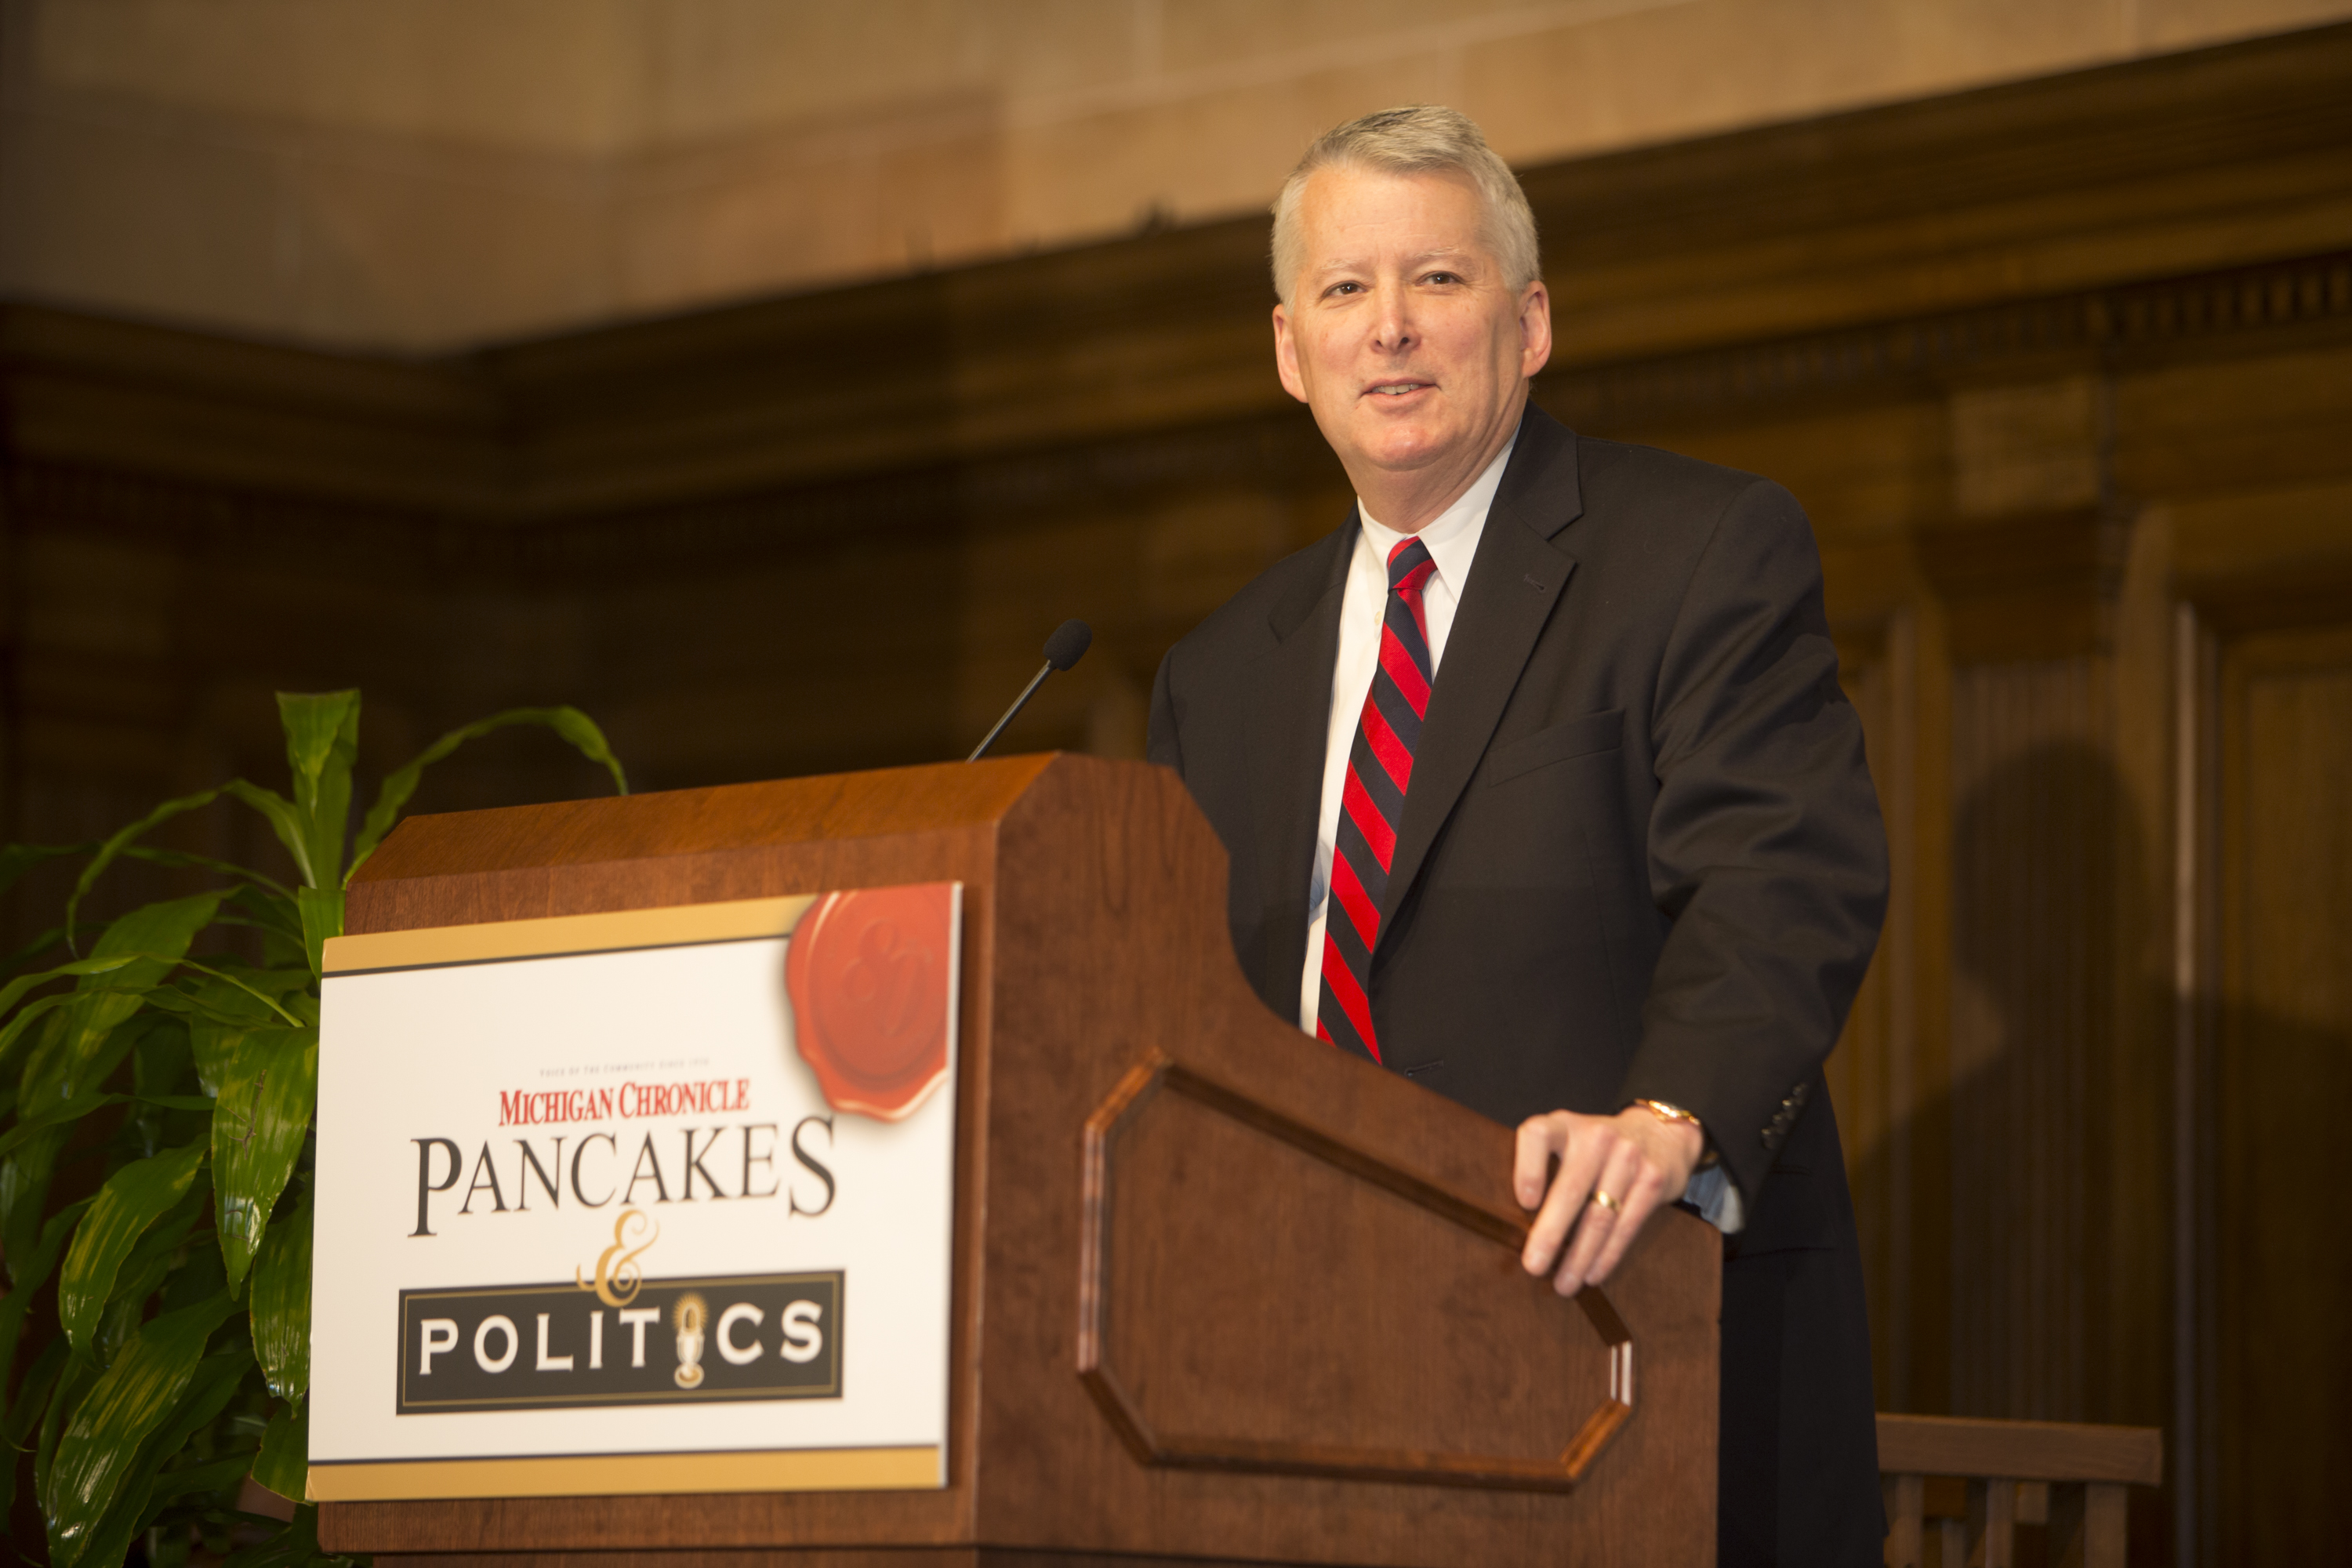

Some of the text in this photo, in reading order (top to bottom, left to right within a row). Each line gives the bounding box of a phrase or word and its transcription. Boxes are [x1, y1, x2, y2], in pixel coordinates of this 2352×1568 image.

[499, 1078, 750, 1127] MICHIGAN CHRONICLE
[407, 1114, 837, 1238] PANCAKES
[575, 1209, 660, 1308] &
